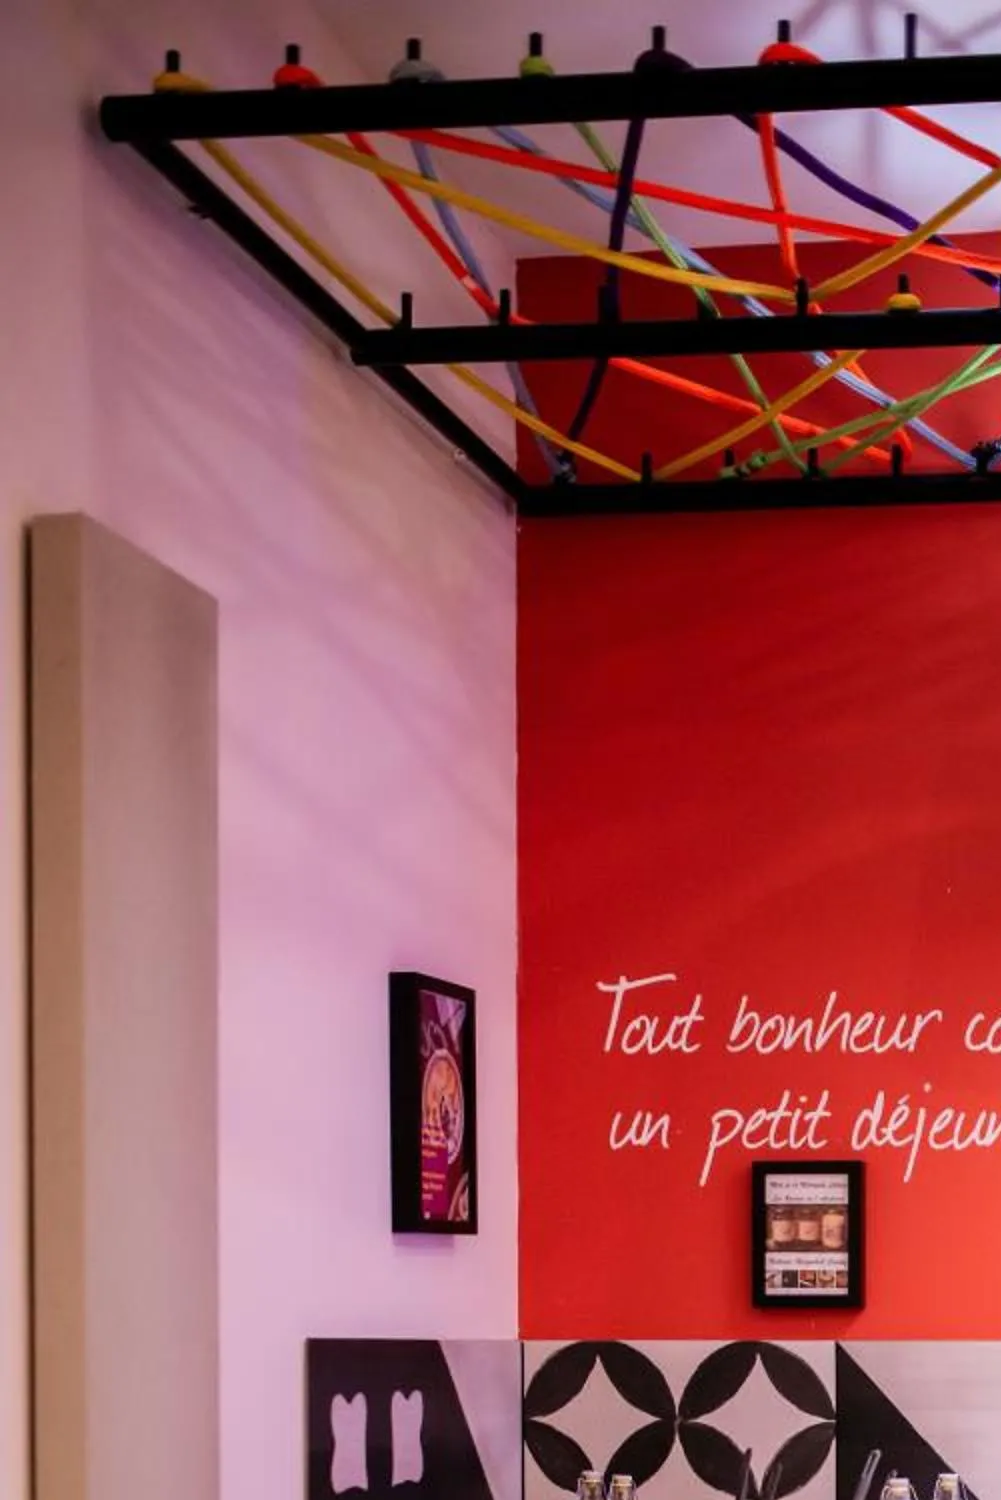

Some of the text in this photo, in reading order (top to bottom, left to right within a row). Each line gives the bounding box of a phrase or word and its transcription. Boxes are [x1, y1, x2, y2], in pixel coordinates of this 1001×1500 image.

[596, 973, 704, 1055] Tout
[726, 991, 943, 1055] bonheur
[609, 1109, 671, 1151] un
[699, 1089, 832, 1187] petit
